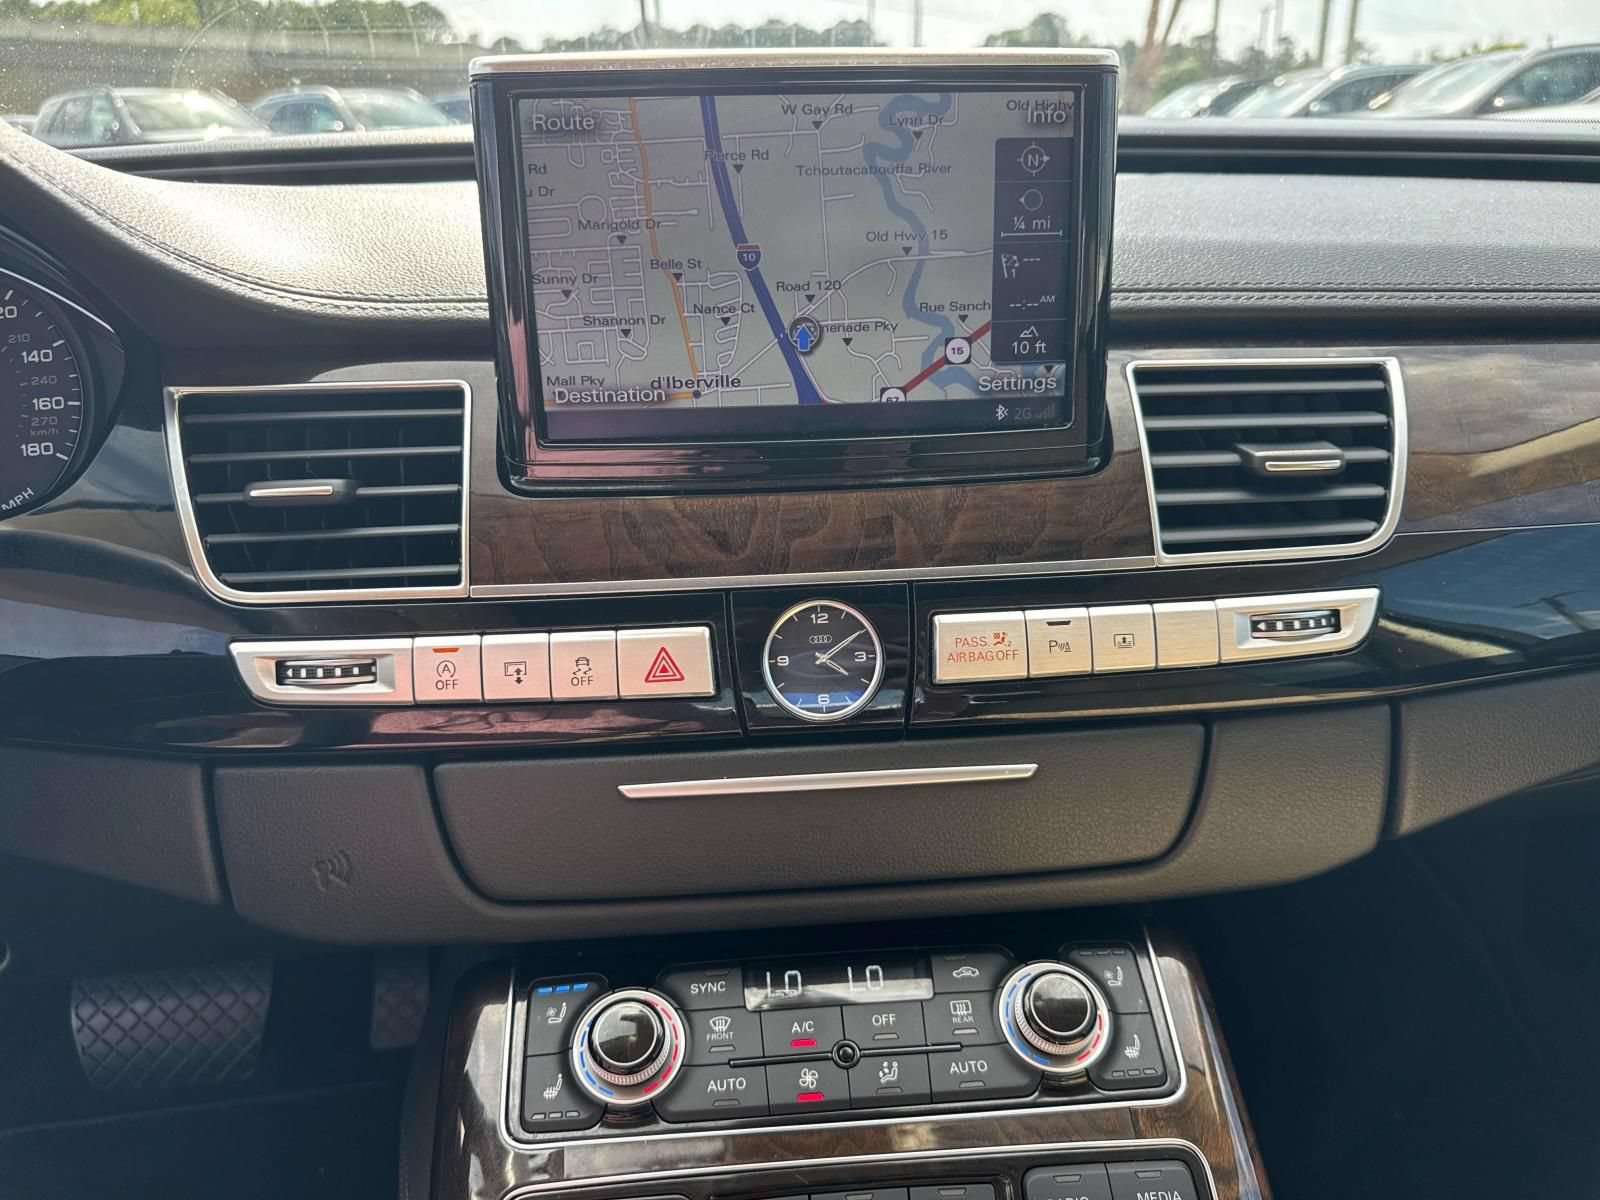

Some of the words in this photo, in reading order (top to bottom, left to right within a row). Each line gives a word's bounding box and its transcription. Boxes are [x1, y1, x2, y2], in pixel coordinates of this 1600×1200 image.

[782, 105, 797, 115] W
[802, 104, 829, 118] Gay
[835, 104, 853, 115] Rd
[1007, 99, 1030, 111] Old
[1028, 104, 1066, 123] Info
[532, 114, 594, 131] Route
[889, 114, 923, 128] Lynn
[928, 114, 944, 125] Dr
[752, 149, 769, 161] Rd
[528, 164, 547, 175] Rd
[918, 162, 952, 174] River
[538, 186, 555, 197] Dr
[578, 218, 640, 232] Marigold
[646, 218, 662, 230] Dr
[1032, 216, 1051, 229] mi
[866, 230, 889, 242] Old
[932, 228, 948, 240] 15
[742, 252, 756, 262] 10
[650, 259, 683, 270] Belle
[686, 259, 702, 270] St
[531, 274, 577, 288] Sunny
[582, 273, 598, 284] Dr
[776, 281, 810, 292] Road
[817, 280, 842, 291] 120
[1040, 294, 1056, 304] AM
[693, 304, 736, 314] Nance
[740, 303, 755, 314] Ct
[920, 302, 945, 312] Rue
[582, 315, 644, 327] Shannon
[650, 315, 666, 326] Dr
[874, 322, 898, 334] Pky
[8, 334, 30, 344] 210
[950, 346, 964, 356] 15
[1011, 340, 1029, 354] 10
[1034, 340, 1047, 354] ft
[21, 349, 53, 364] 140
[32, 376, 58, 386] 240
[546, 376, 577, 387] Mall
[581, 376, 605, 389] Pky
[978, 375, 1057, 394] Settings
[554, 388, 666, 404] Destination
[32, 396, 64, 410] 160
[1014, 406, 1032, 420] 2G
[32, 416, 58, 426] 270
[30, 428, 59, 436] km/h
[20, 442, 54, 456] 180
[1, 487, 35, 511] MPH
[810, 612, 829, 624] 12
[776, 656, 789, 666] 9
[854, 651, 866, 662] 3
[947, 650, 994, 664] AIRBAG
[996, 650, 1018, 662] OFF
[435, 679, 459, 691] OFF
[570, 675, 594, 687] OFF
[818, 694, 830, 704] 6
[766, 970, 802, 998] LO
[848, 964, 884, 992] LO
[690, 981, 726, 994] SYNC
[872, 1014, 896, 1026] OFF
[952, 1015, 974, 1024] REAR
[791, 1020, 814, 1033] A/C
[706, 1030, 734, 1041] FRONT
[950, 1060, 988, 1074] AUTO
[707, 1078, 746, 1092] AUTO
